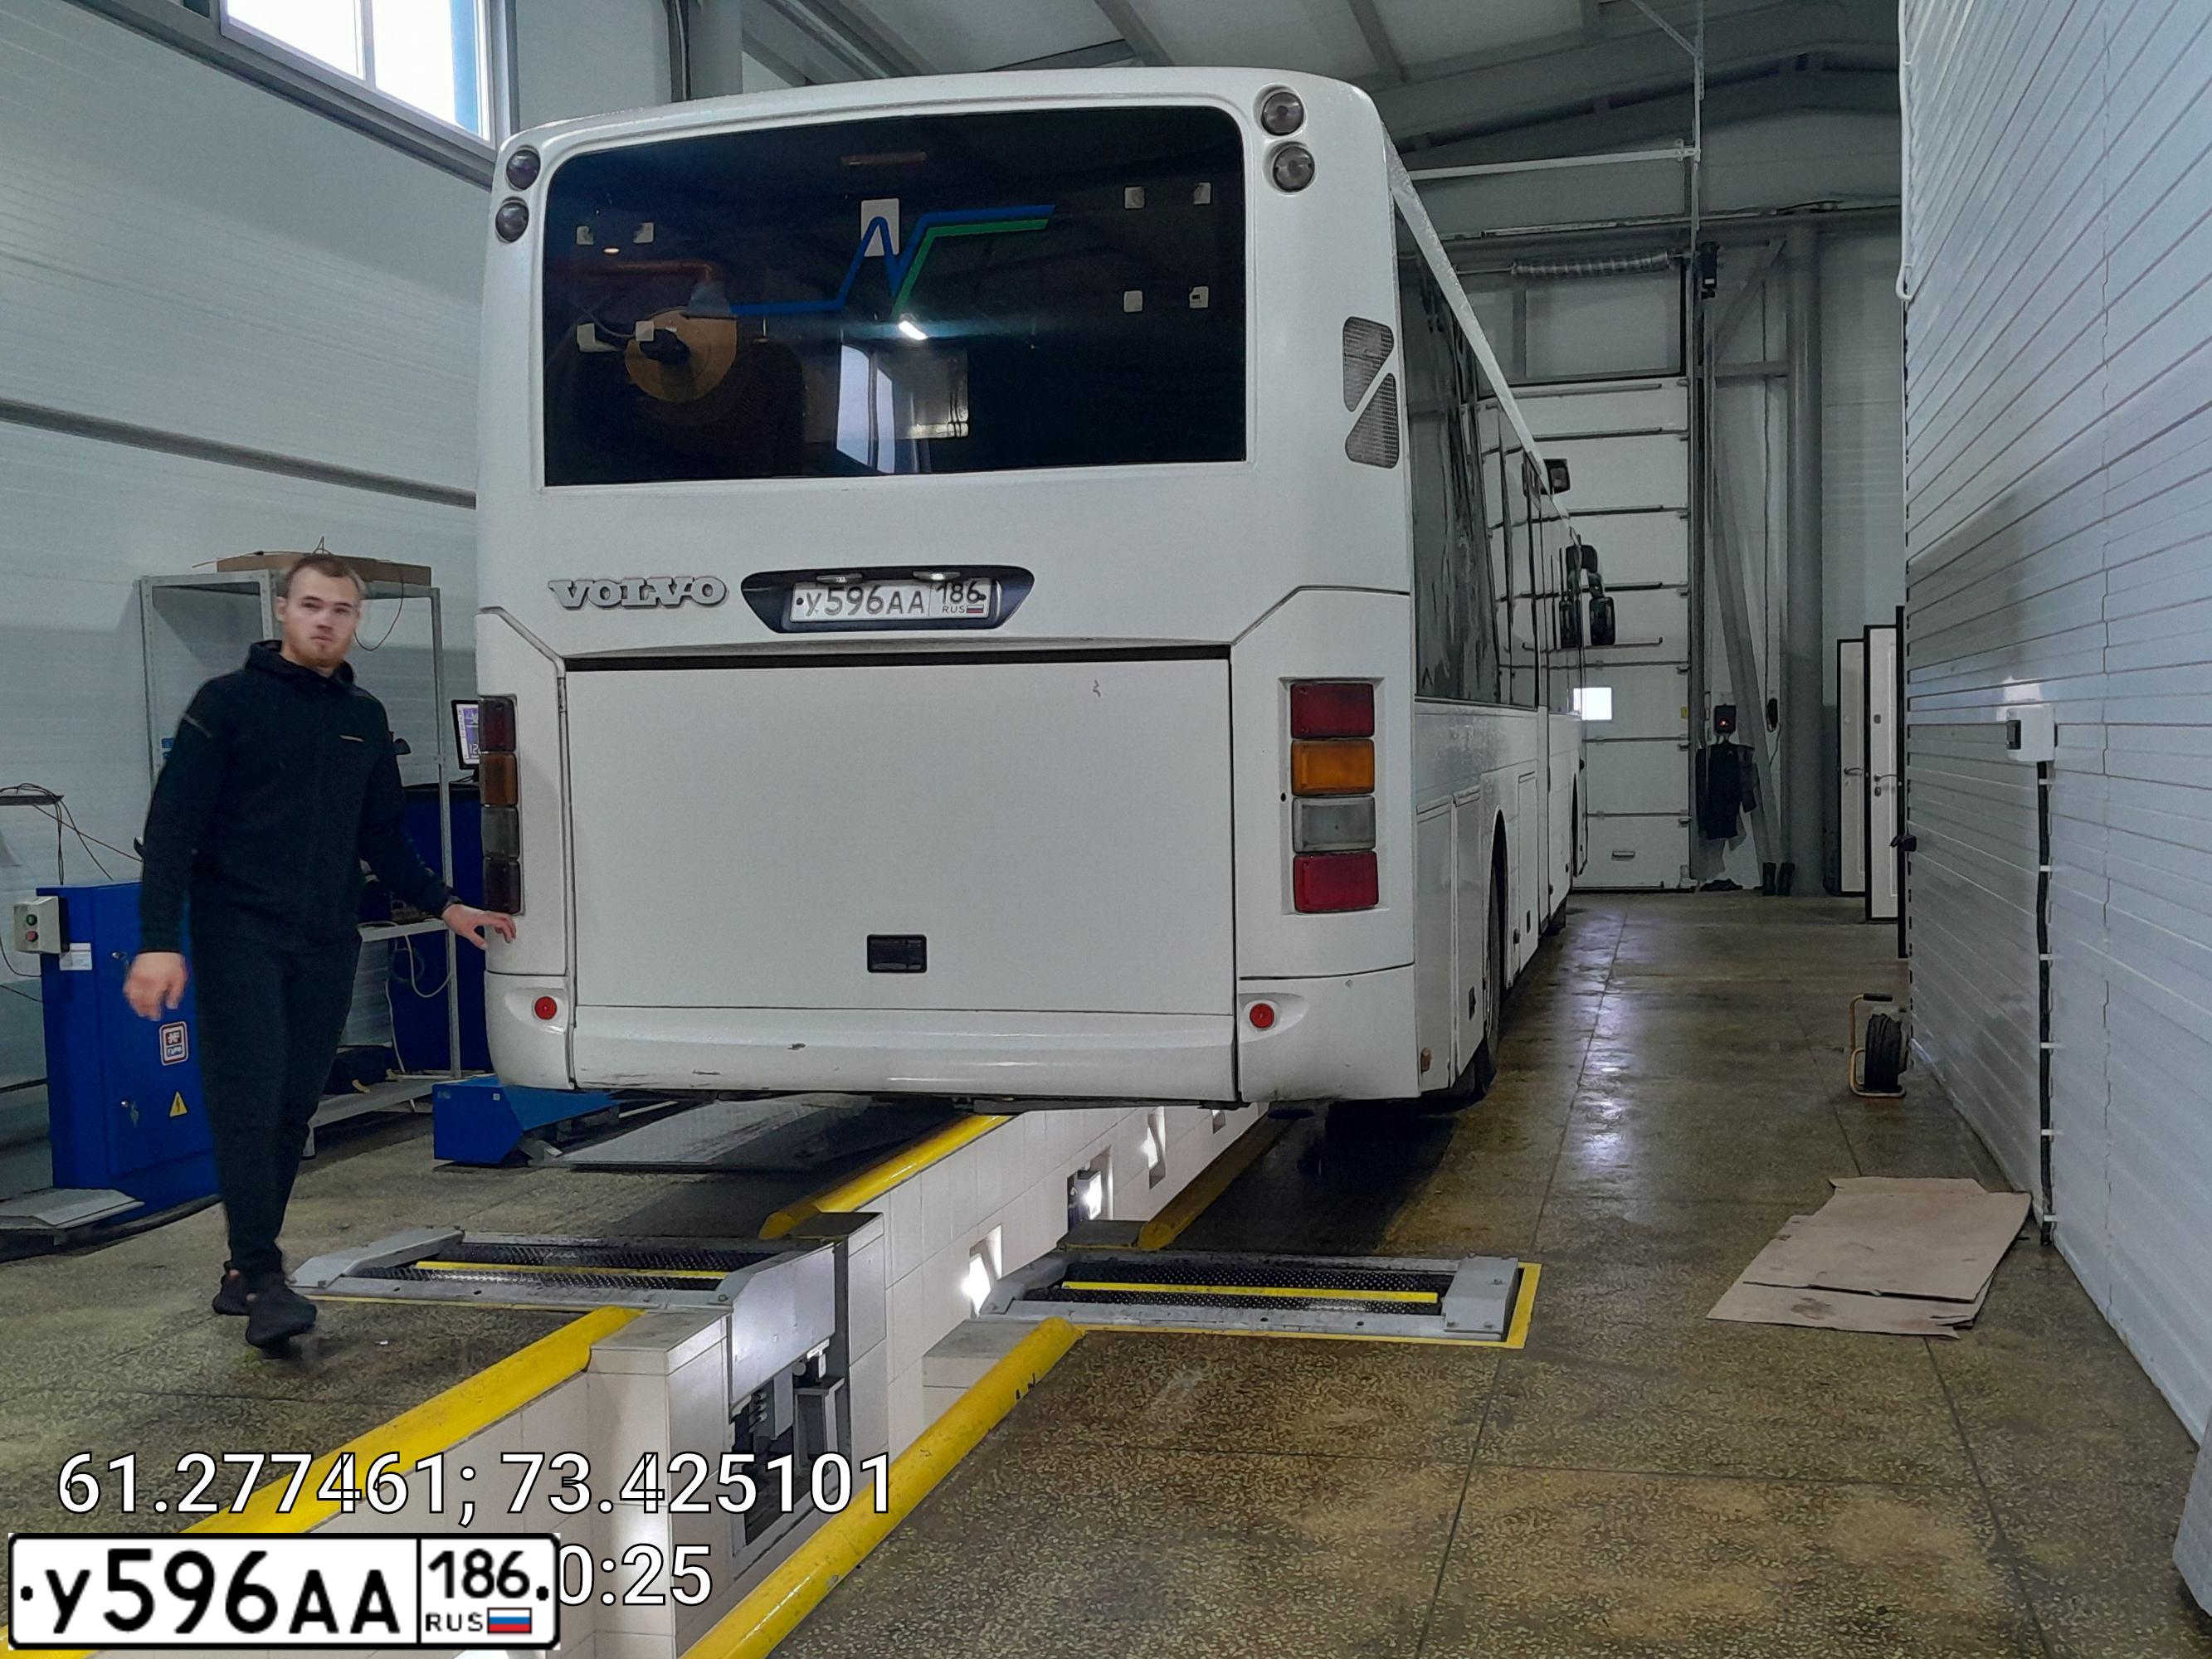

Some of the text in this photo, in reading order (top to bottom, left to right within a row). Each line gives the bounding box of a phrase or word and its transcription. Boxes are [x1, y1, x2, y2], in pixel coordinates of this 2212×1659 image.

[548, 577, 728, 610] VOLVO
[936, 581, 979, 604] 186
[942, 605, 965, 615] RUS
